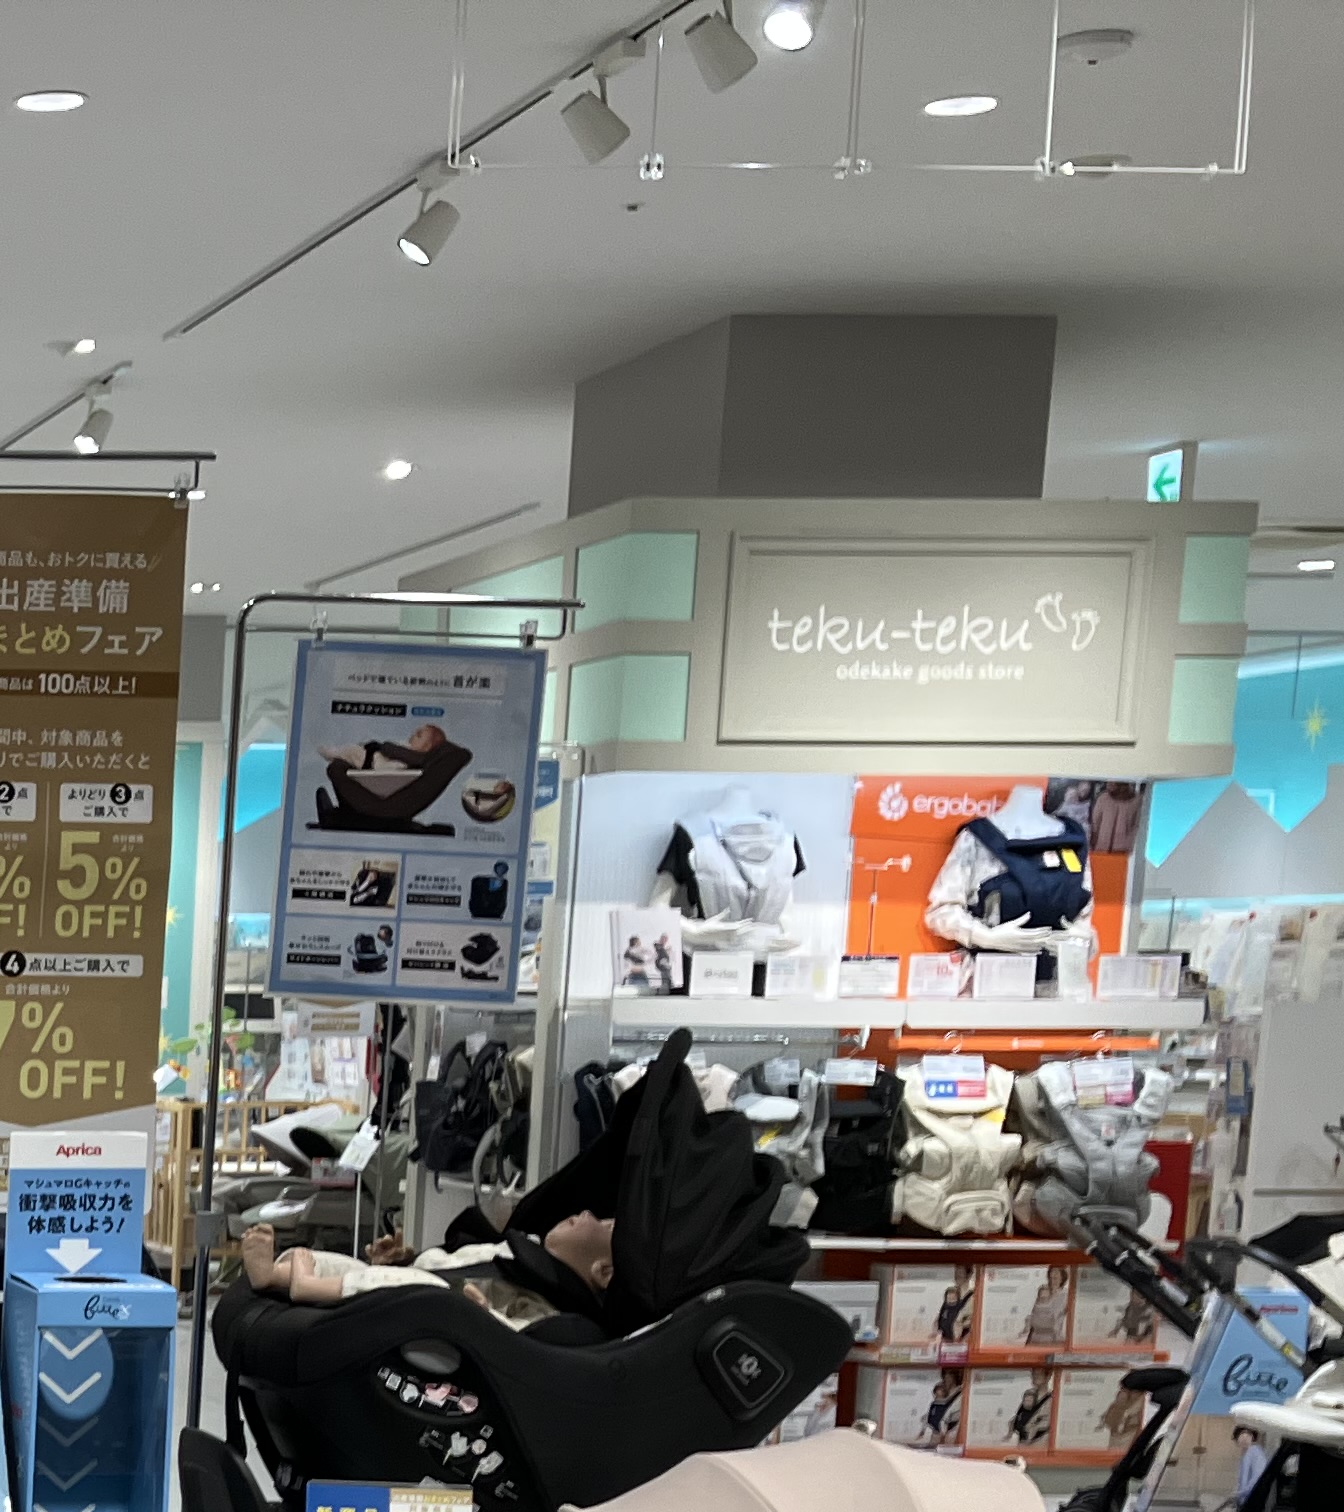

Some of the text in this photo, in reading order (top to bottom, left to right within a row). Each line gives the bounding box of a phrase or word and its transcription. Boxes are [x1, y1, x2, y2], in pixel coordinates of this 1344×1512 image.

[767, 603, 1034, 654] teku-teku
[836, 662, 1026, 684] odekake goods store
[83, 805, 129, 818] ご購入で
[56, 830, 147, 901] 5%
[54, 903, 143, 939] OFF!
[19, 1059, 125, 1101] OFF!
[55, 1144, 103, 1158] Aprica
[24, 1178, 131, 1191] マシュマロGキャッチの
[18, 1192, 134, 1213] 衝撃吸収力を
[27, 1216, 126, 1236] 体感しよう!
